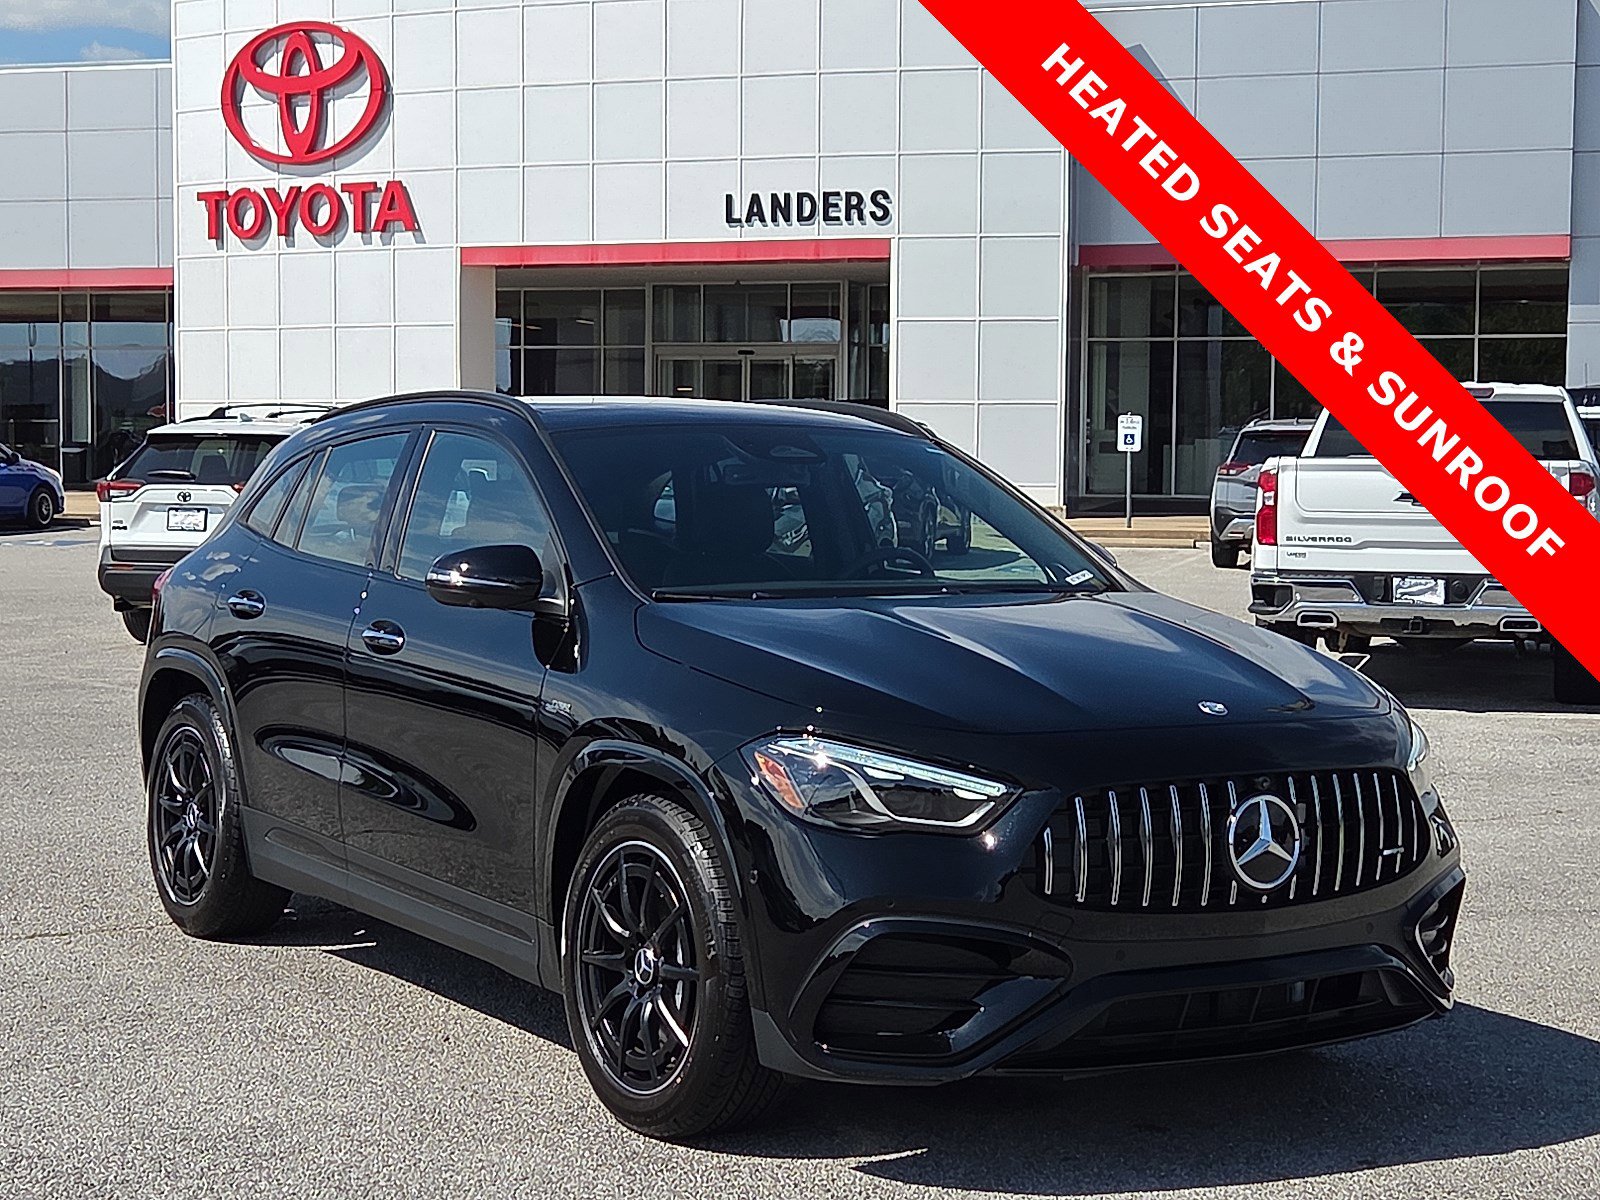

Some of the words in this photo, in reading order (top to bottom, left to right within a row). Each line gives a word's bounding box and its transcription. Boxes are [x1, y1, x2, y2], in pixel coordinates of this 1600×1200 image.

[197, 180, 418, 240] TOYOTA
[725, 189, 892, 226] LANDERS
[1285, 535, 1352, 543] SILVERADO
